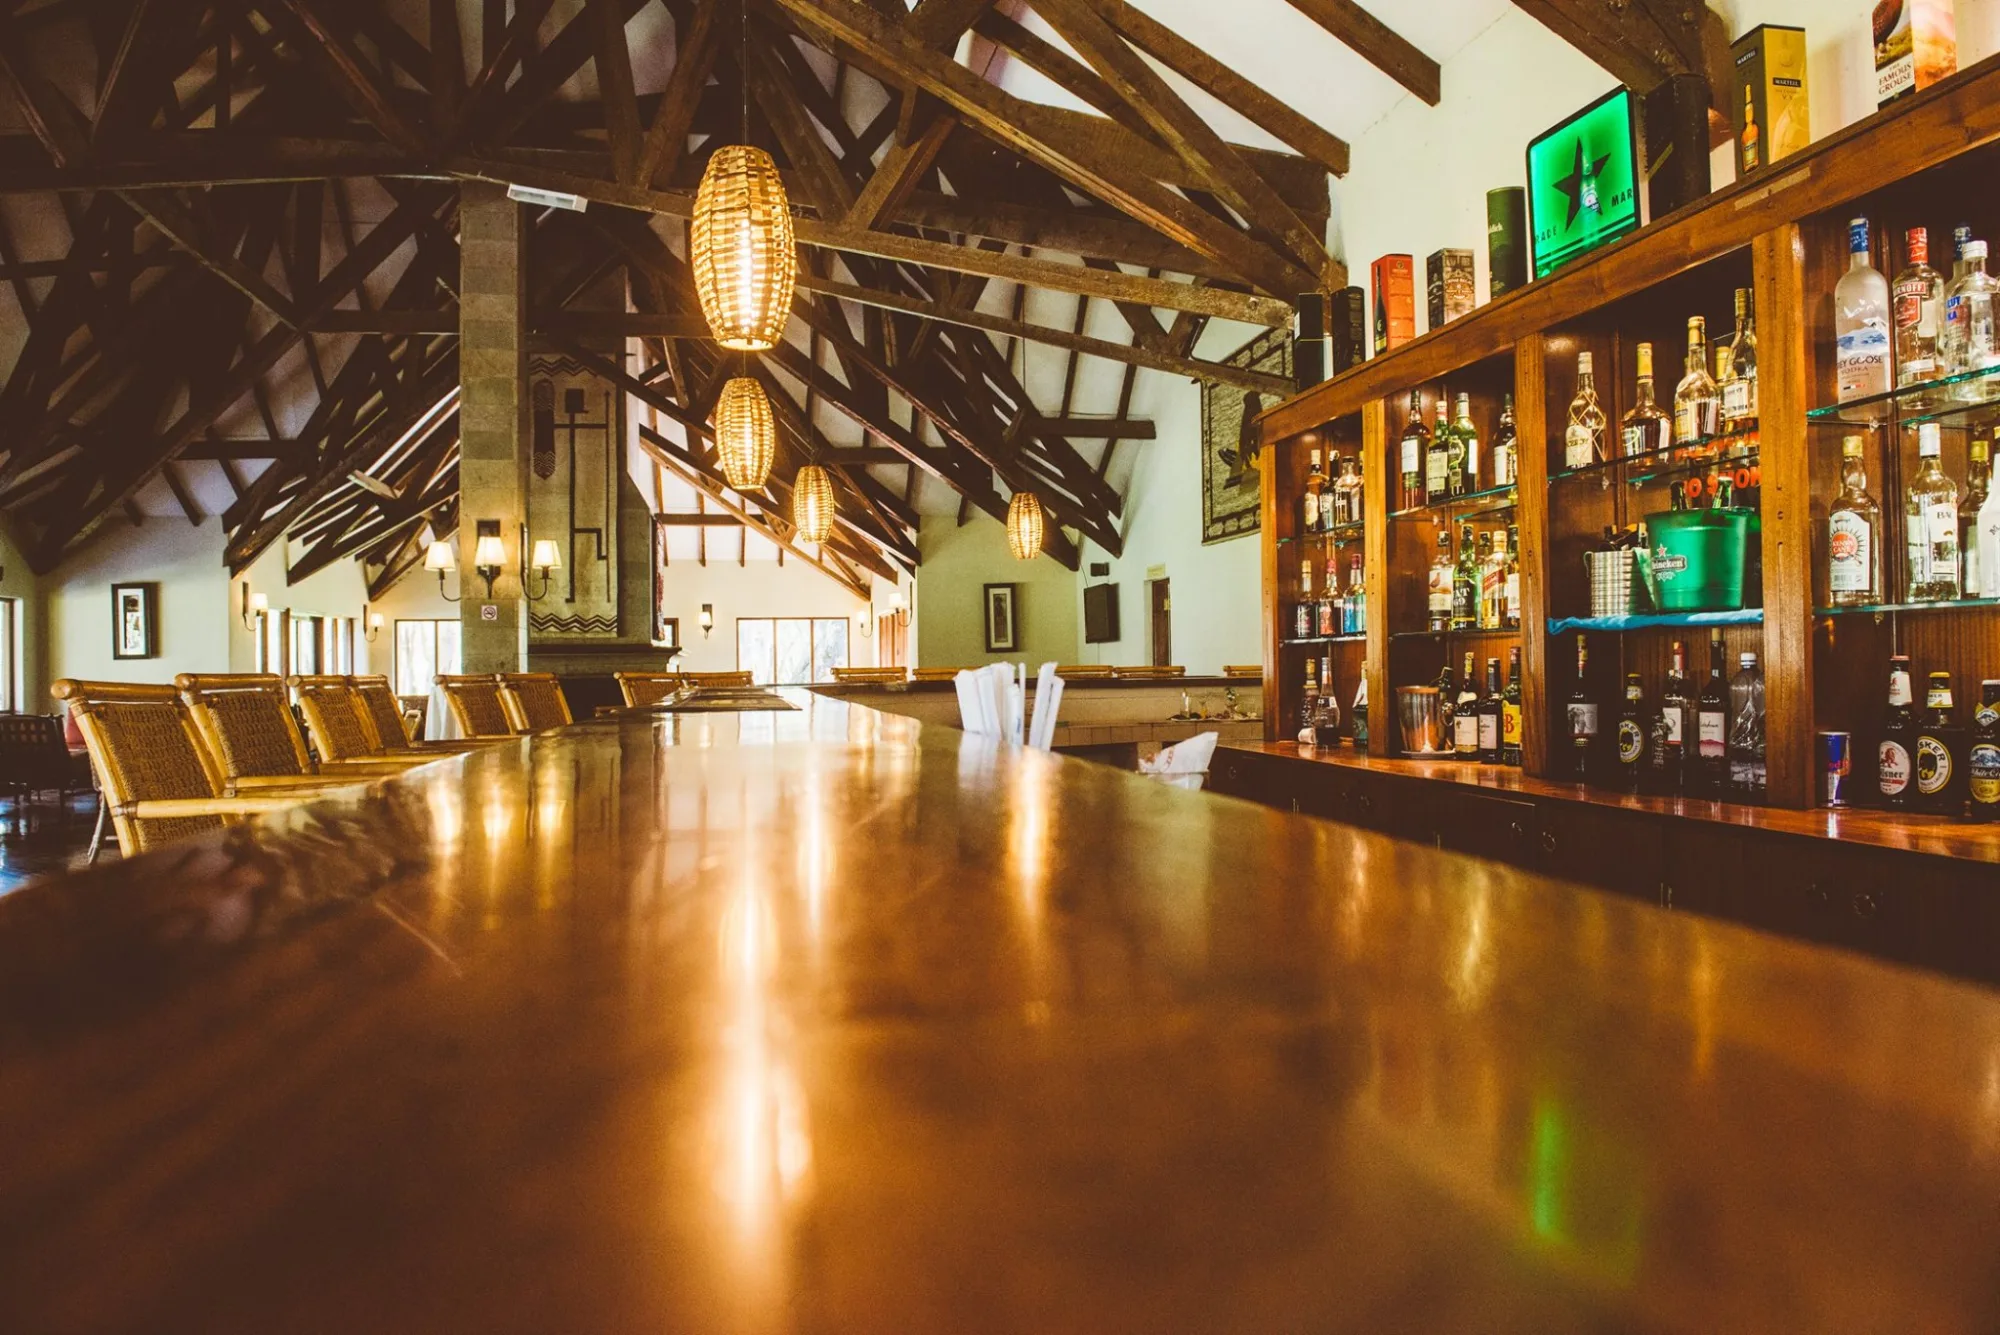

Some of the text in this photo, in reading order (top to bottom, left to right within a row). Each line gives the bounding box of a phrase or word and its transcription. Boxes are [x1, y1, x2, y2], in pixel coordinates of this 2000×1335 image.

[1736, 49, 1757, 65] MARTELL
[1774, 78, 1799, 87] MARTELL
[1878, 71, 1911, 95] GROUSE
[1879, 61, 1912, 86] FAMOUS
[1611, 187, 1633, 208] MAR
[1849, 355, 1883, 367] GOOSE
[1505, 713, 1515, 734] B
[1919, 741, 1946, 762] SKER
